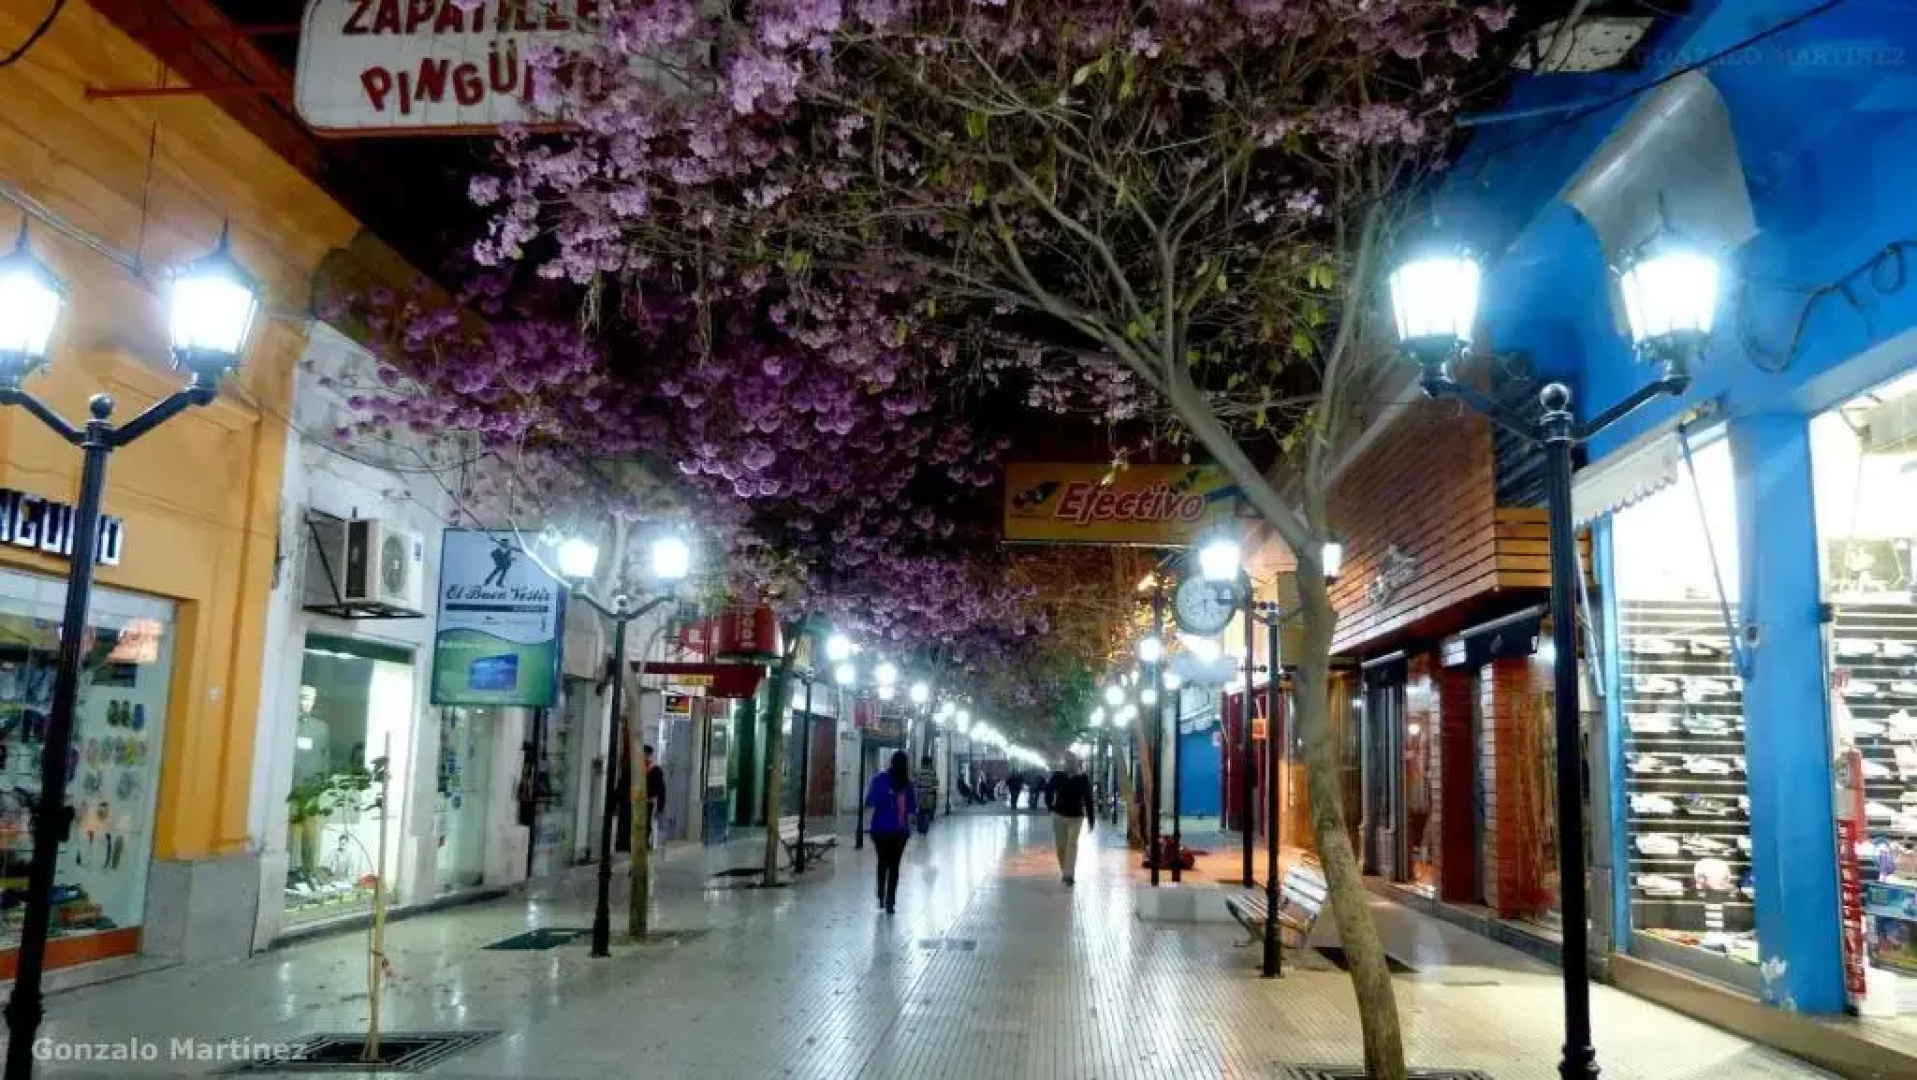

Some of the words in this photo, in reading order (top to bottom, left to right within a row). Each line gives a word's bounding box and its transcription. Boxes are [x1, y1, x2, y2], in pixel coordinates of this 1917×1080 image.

[1055, 480, 1206, 525] Efectivo
[446, 587, 465, 600] El
[466, 587, 507, 600] Buen
